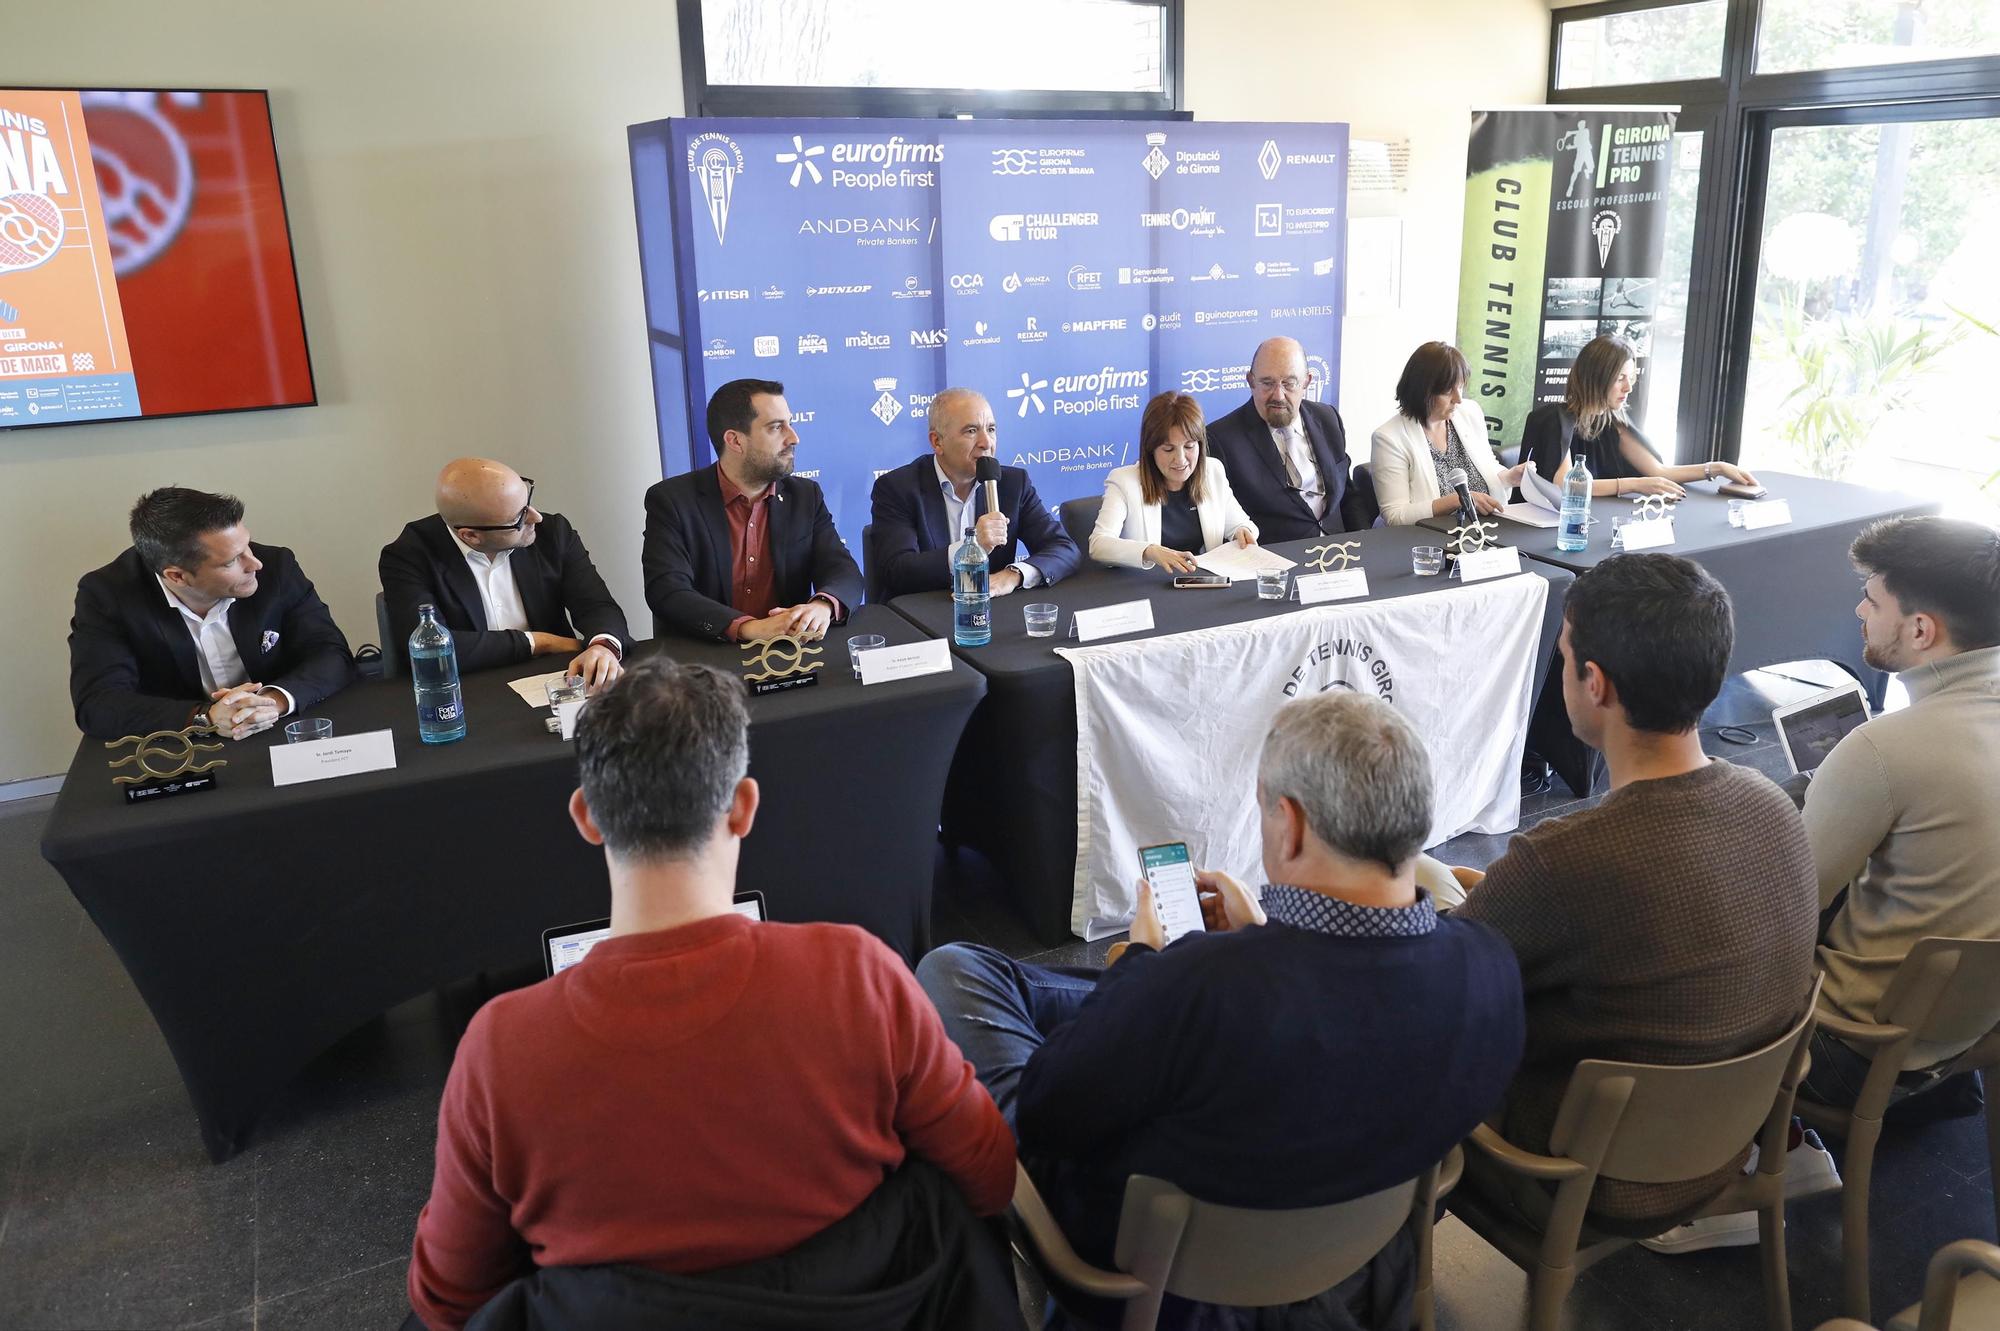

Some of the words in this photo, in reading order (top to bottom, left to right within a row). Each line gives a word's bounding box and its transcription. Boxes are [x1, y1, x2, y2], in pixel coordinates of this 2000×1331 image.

[0, 108, 47, 136] NIS
[700, 132, 730, 143] TENNIS
[1613, 124, 1671, 146] GIRONA
[690, 138, 701, 150] DE
[729, 142, 744, 173] GIRONA
[832, 136, 945, 168] eurofirms
[1039, 149, 1085, 157] EUROFIRMS
[1176, 149, 1220, 163] Diputació
[1286, 154, 1336, 164] RENAULT
[1611, 143, 1667, 165] TENNIS
[687, 149, 696, 172] CLUB
[1039, 158, 1072, 166] GIRONA
[1039, 167, 1067, 175] COSTA
[1068, 167, 1095, 175] BRAVA
[1176, 163, 1187, 174] de
[1189, 162, 1220, 174] Girona
[1609, 165, 1641, 184] PRO
[832, 169, 897, 191] People
[900, 169, 935, 188] first
[1556, 199, 1589, 211] ESCOLA
[1593, 192, 1663, 208] PROFESSIONAL
[798, 216, 921, 235] ANDBANK
[1026, 213, 1099, 227] CHALLENGER
[1141, 213, 1171, 227] TENNIS
[1492, 177, 1522, 262] CLUB
[1026, 226, 1058, 241] TOUR
[856, 237, 884, 246] Private
[886, 236, 918, 246] Bankers
[1077, 272, 1103, 283] RFET
[1133, 267, 1168, 276] Generalitat
[950, 273, 984, 289] OCA
[1142, 275, 1174, 284] Catalunya
[818, 285, 872, 295] DUNLOP
[1159, 312, 1181, 322] audit
[1205, 308, 1258, 321] guinotprunera
[1271, 307, 1296, 319] BRAVA
[1298, 305, 1332, 317] HOTELES
[1072, 319, 1127, 332] MAPFRE
[1017, 331, 1048, 340] REIXACH
[1480, 282, 1514, 398] TENNIS
[4, 341, 57, 352] GIRONA
[703, 349, 735, 357] BOMBON
[2, 359, 17, 374] DE
[1221, 365, 1251, 374] EUROFIR
[1053, 366, 1148, 397] eurofirms
[1221, 382, 1245, 390] COSTA
[1053, 398, 1108, 417] People
[1111, 395, 1139, 410] first
[1012, 443, 1115, 466] ANDBANK
[1060, 463, 1085, 473] Private
[1086, 460, 1113, 471] Bankers
[1282, 666, 1306, 697] DE
[1307, 638, 1373, 666] TENNIS
[1370, 659, 1393, 704] GIRO
